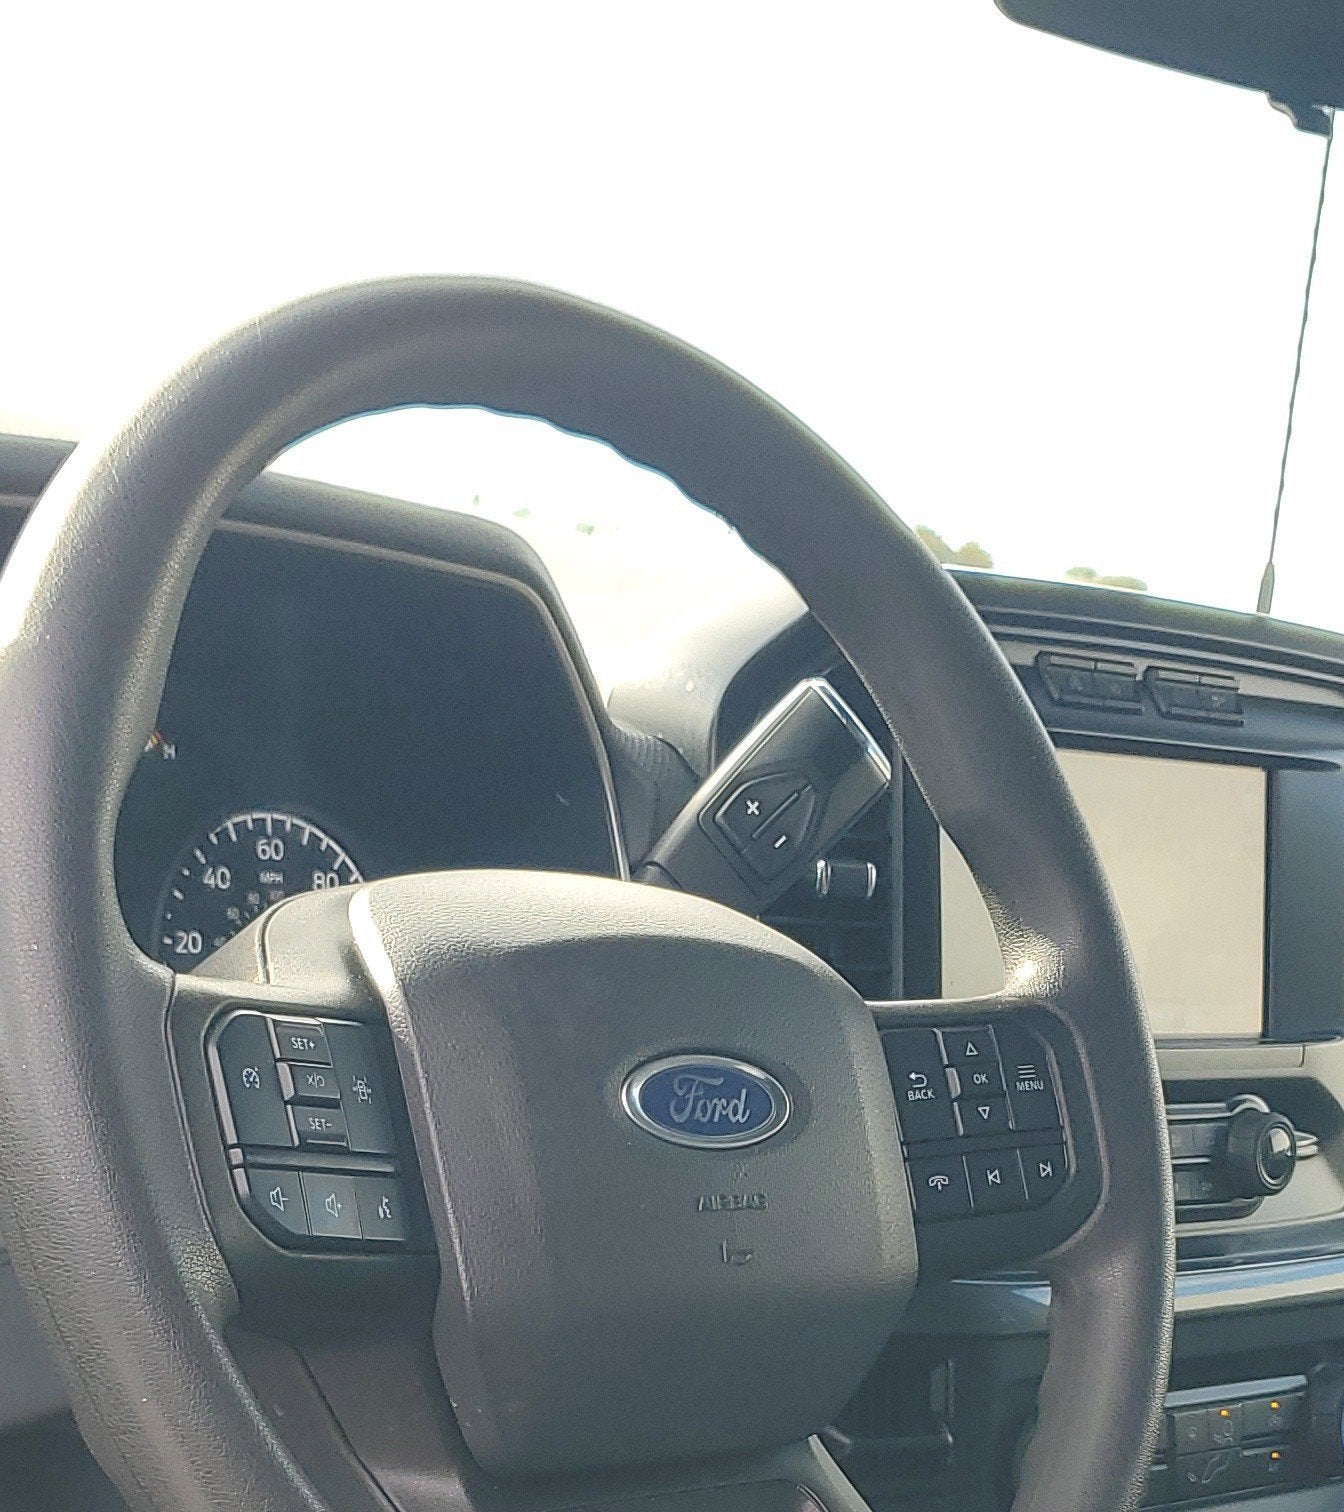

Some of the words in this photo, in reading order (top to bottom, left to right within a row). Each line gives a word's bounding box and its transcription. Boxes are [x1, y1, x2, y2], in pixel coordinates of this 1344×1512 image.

[257, 838, 284, 861] 60
[203, 865, 231, 890] 40
[312, 870, 339, 890] 80
[175, 930, 202, 955] 20
[973, 1073, 988, 1085] OK
[1016, 1080, 1044, 1092] MENU
[669, 1074, 750, 1123] Ford
[908, 1088, 935, 1101] BACK
